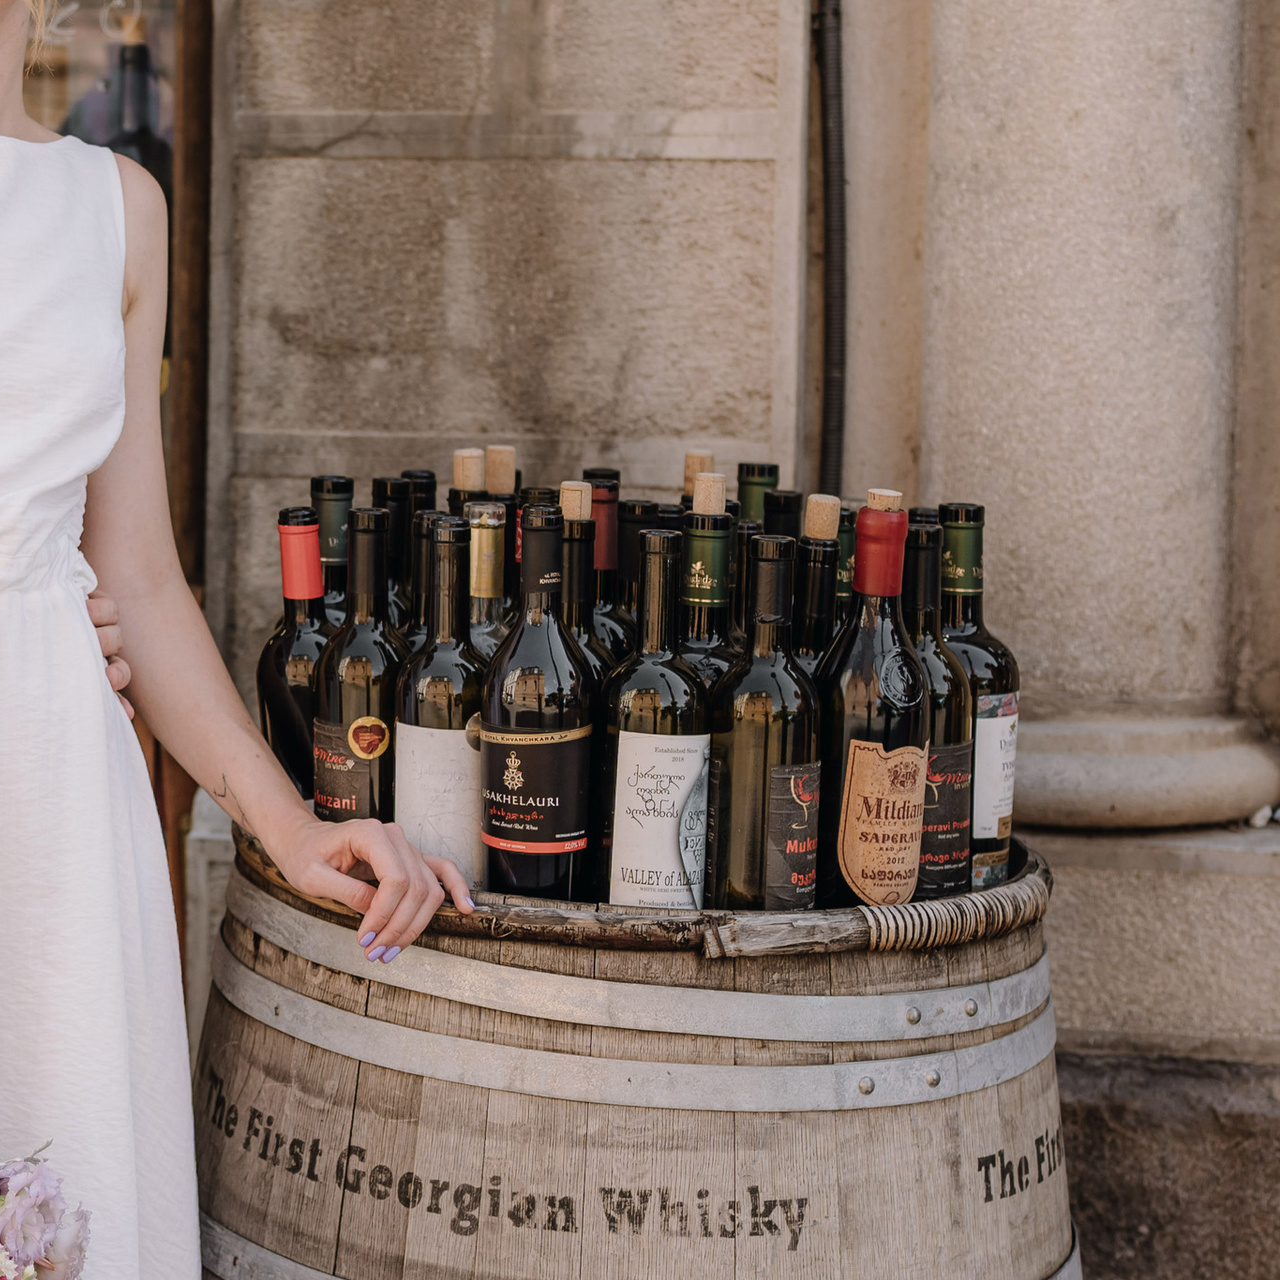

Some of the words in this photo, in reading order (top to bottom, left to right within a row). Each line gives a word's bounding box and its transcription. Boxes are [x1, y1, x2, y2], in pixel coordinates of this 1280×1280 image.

[481, 788, 560, 807] USAKHELAURI
[621, 867, 663, 886] VALLEY
[664, 870, 675, 887] of
[204, 1066, 239, 1139] The
[243, 1106, 324, 1183] First
[334, 1144, 581, 1237] Georgian
[597, 1185, 809, 1252] Whisky
[977, 1147, 1030, 1204] The
